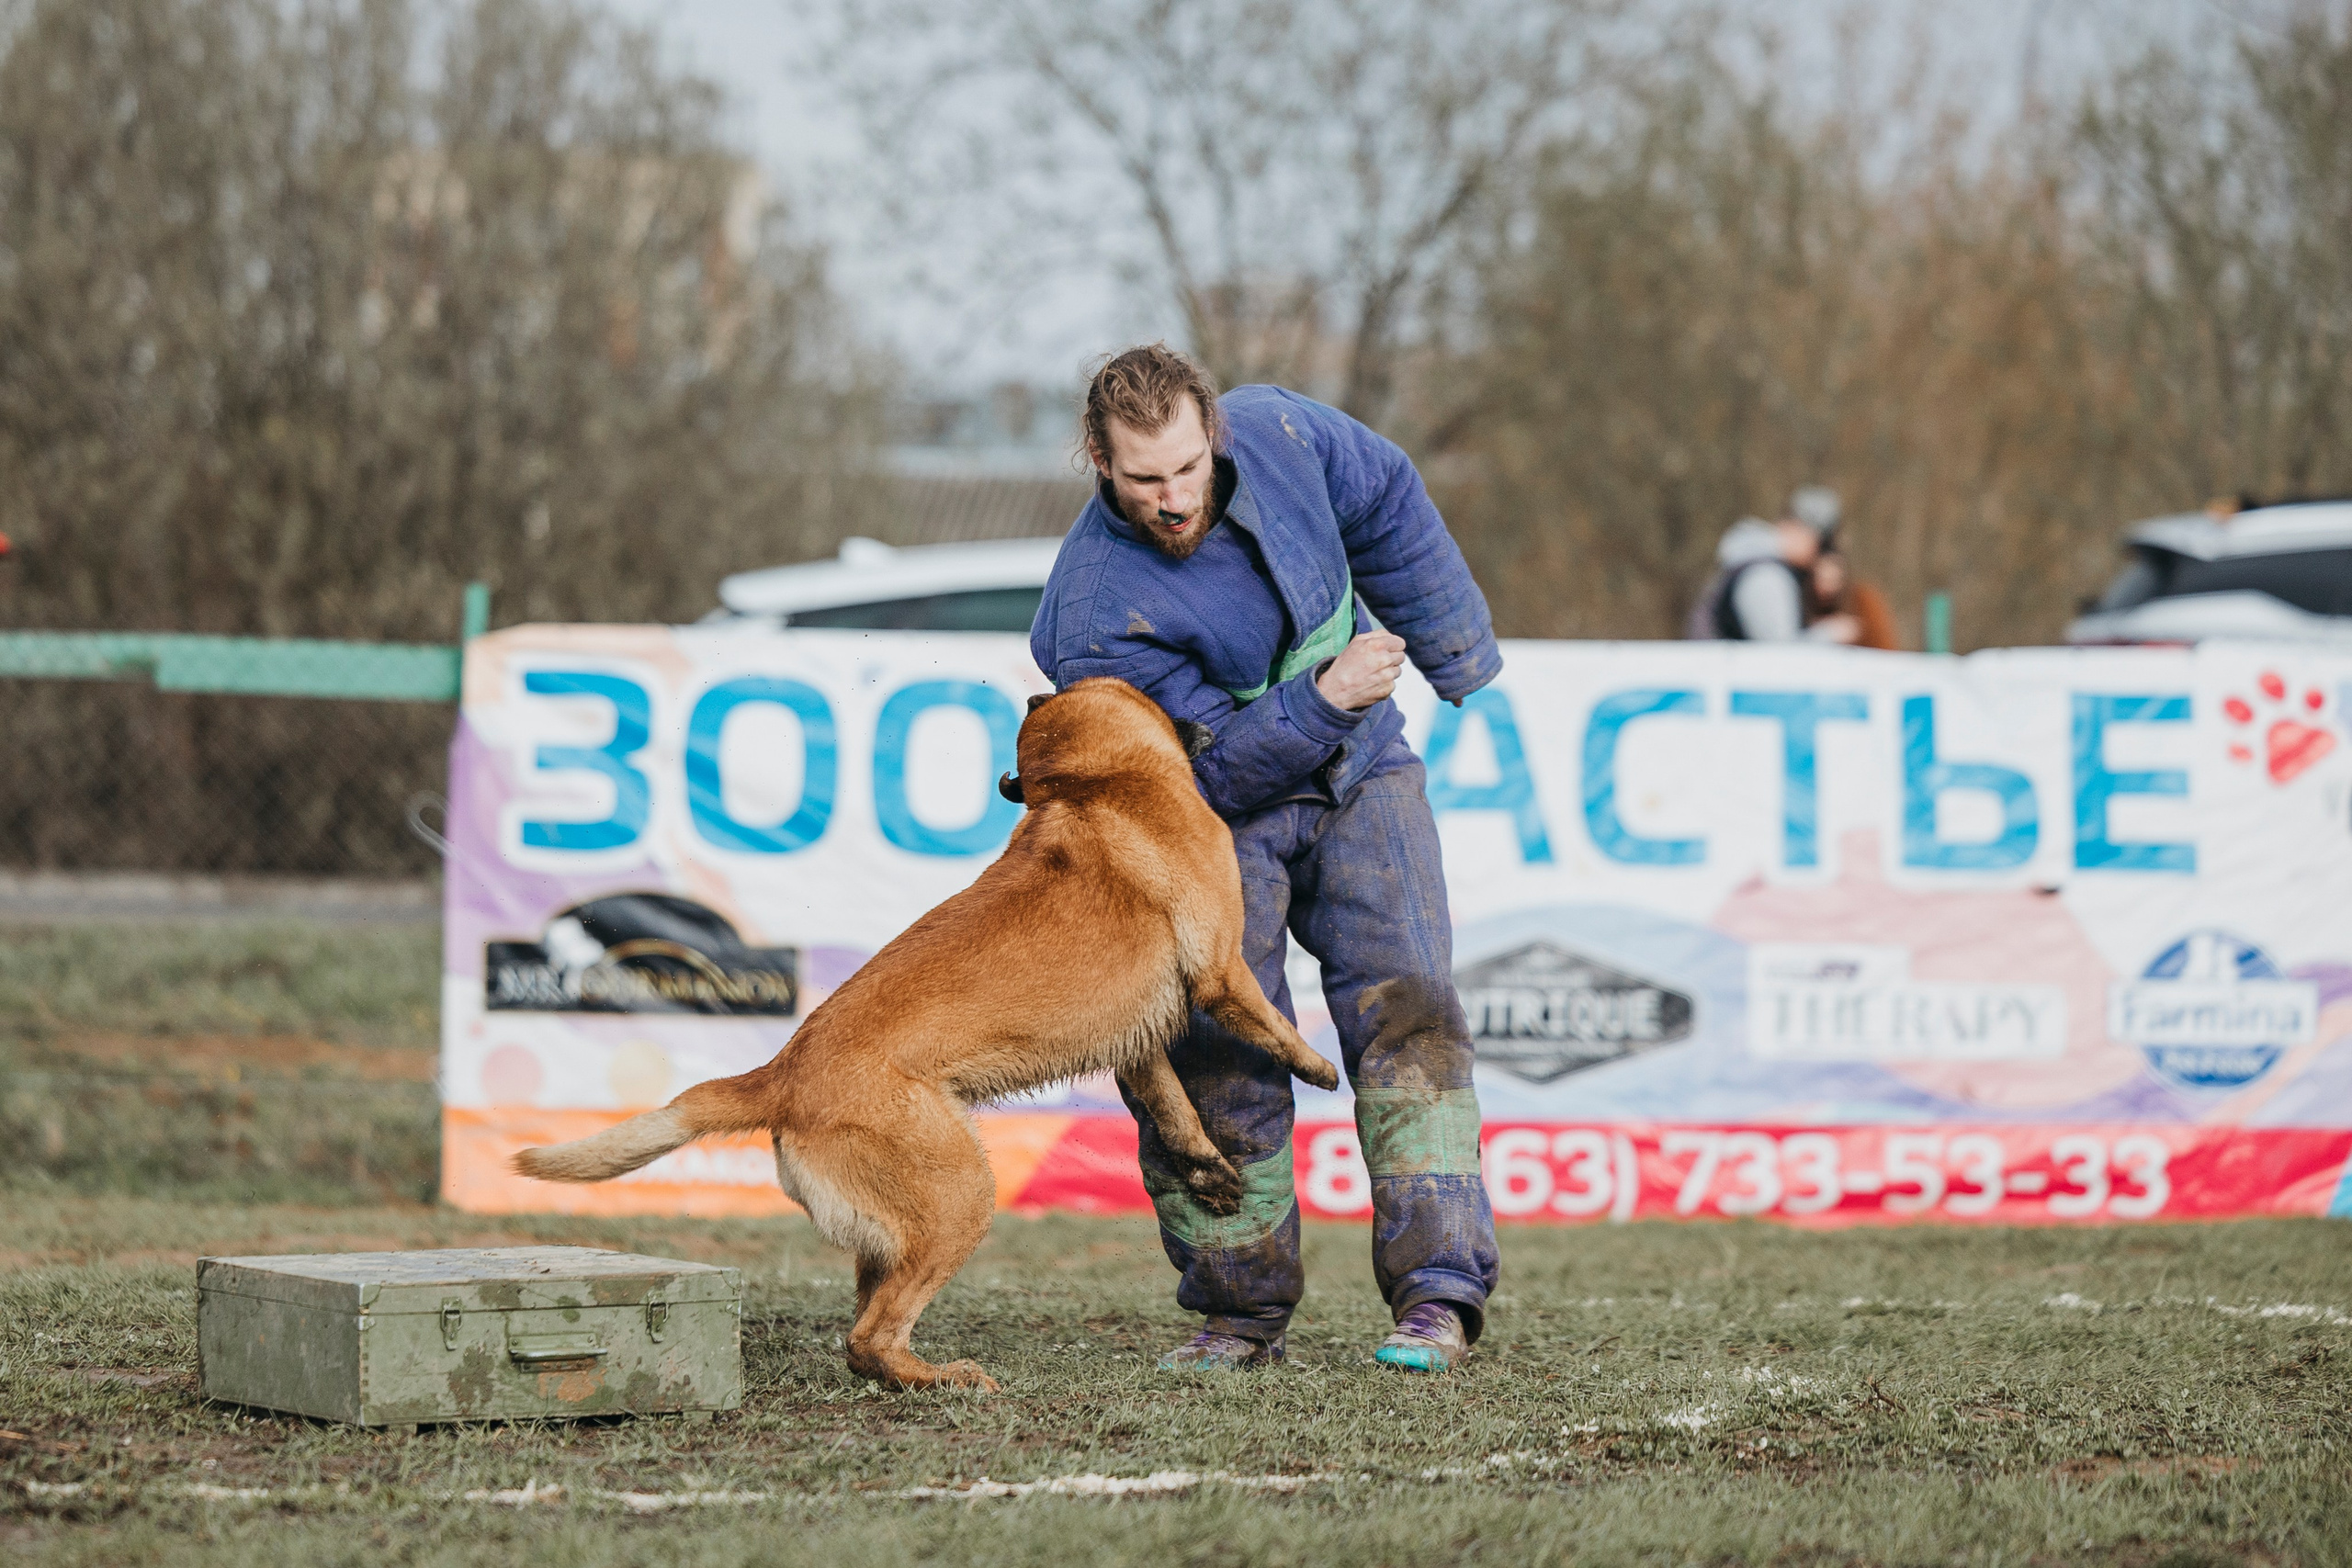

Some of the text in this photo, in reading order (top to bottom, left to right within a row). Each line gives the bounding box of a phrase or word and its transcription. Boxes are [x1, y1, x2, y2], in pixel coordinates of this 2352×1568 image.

[523, 670, 2196, 873] ЗООАСТЬЕ
[1459, 987, 1661, 1040] UTRIQUE
[1483, 1129, 1638, 1221] 63)
[1660, 1131, 2171, 1219] 733-53-33
